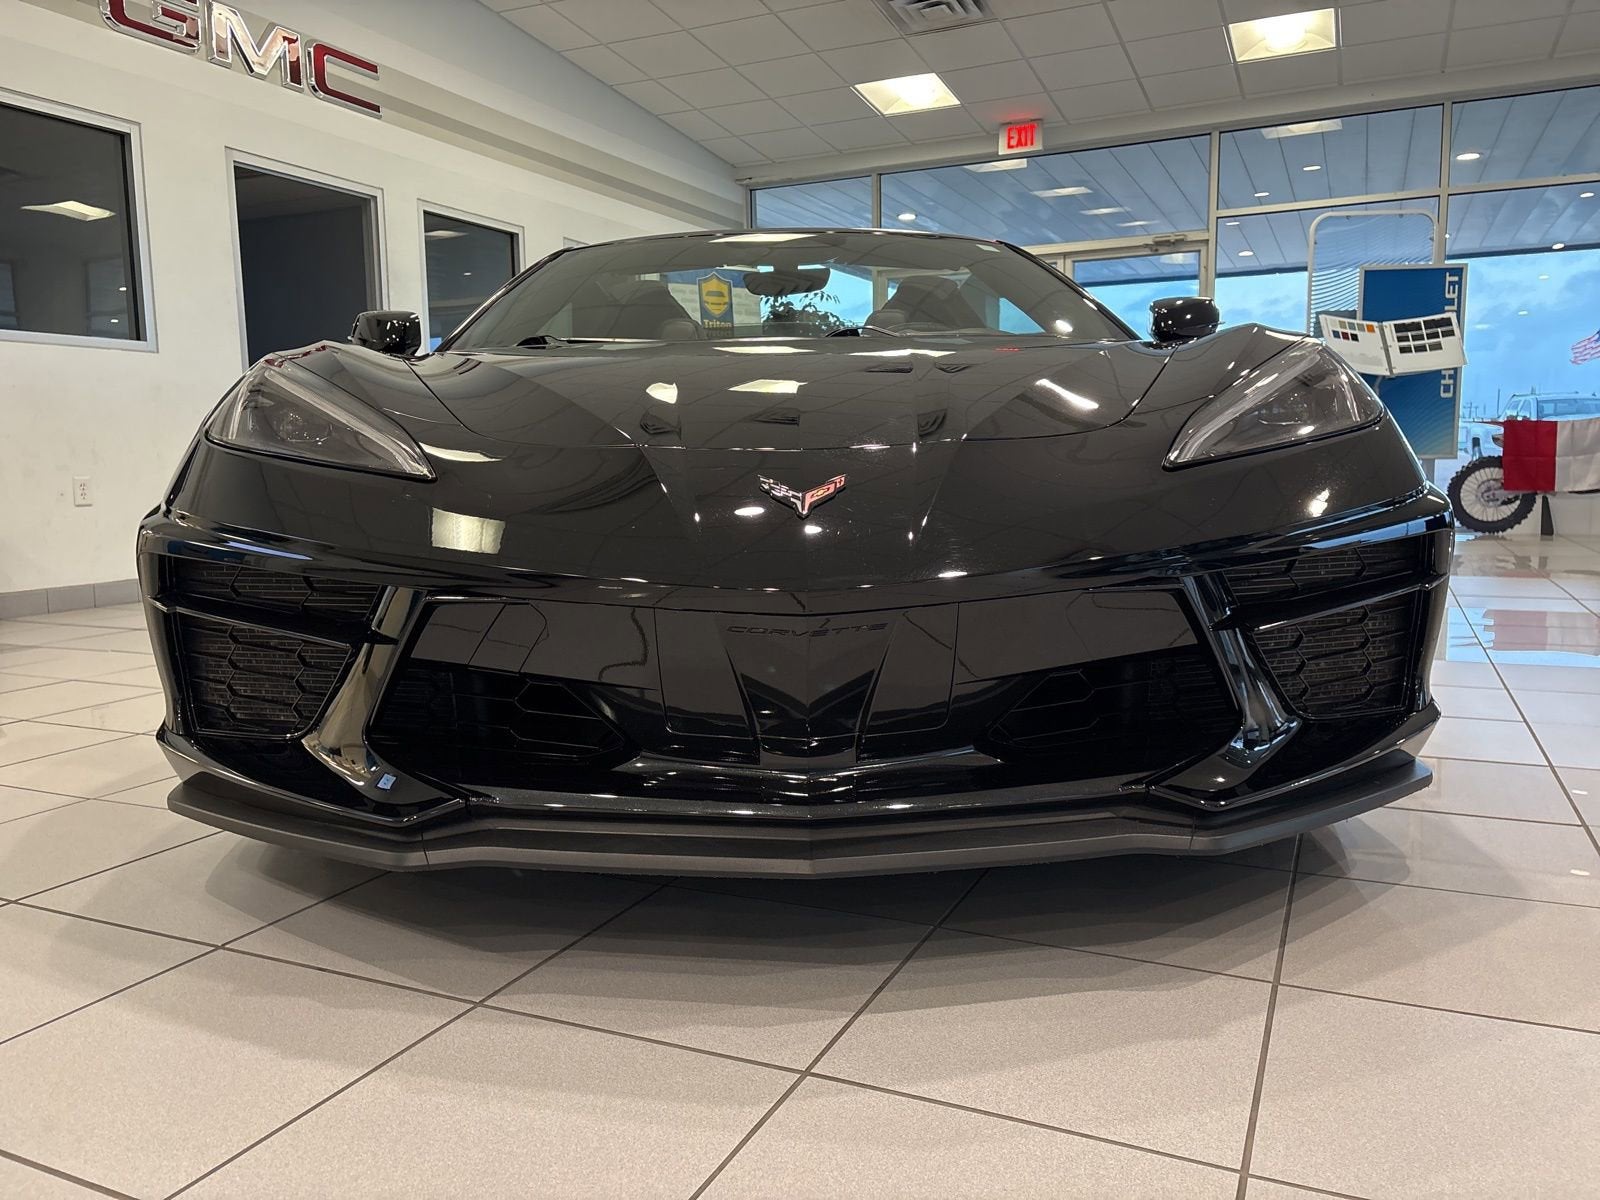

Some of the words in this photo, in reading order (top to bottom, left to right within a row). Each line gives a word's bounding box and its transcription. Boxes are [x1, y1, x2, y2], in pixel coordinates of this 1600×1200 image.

[100, 0, 382, 119] GMC
[1007, 122, 1037, 149] EXIT
[1440, 272, 1460, 398] CHLET
[726, 622, 889, 637] CORVETTE
